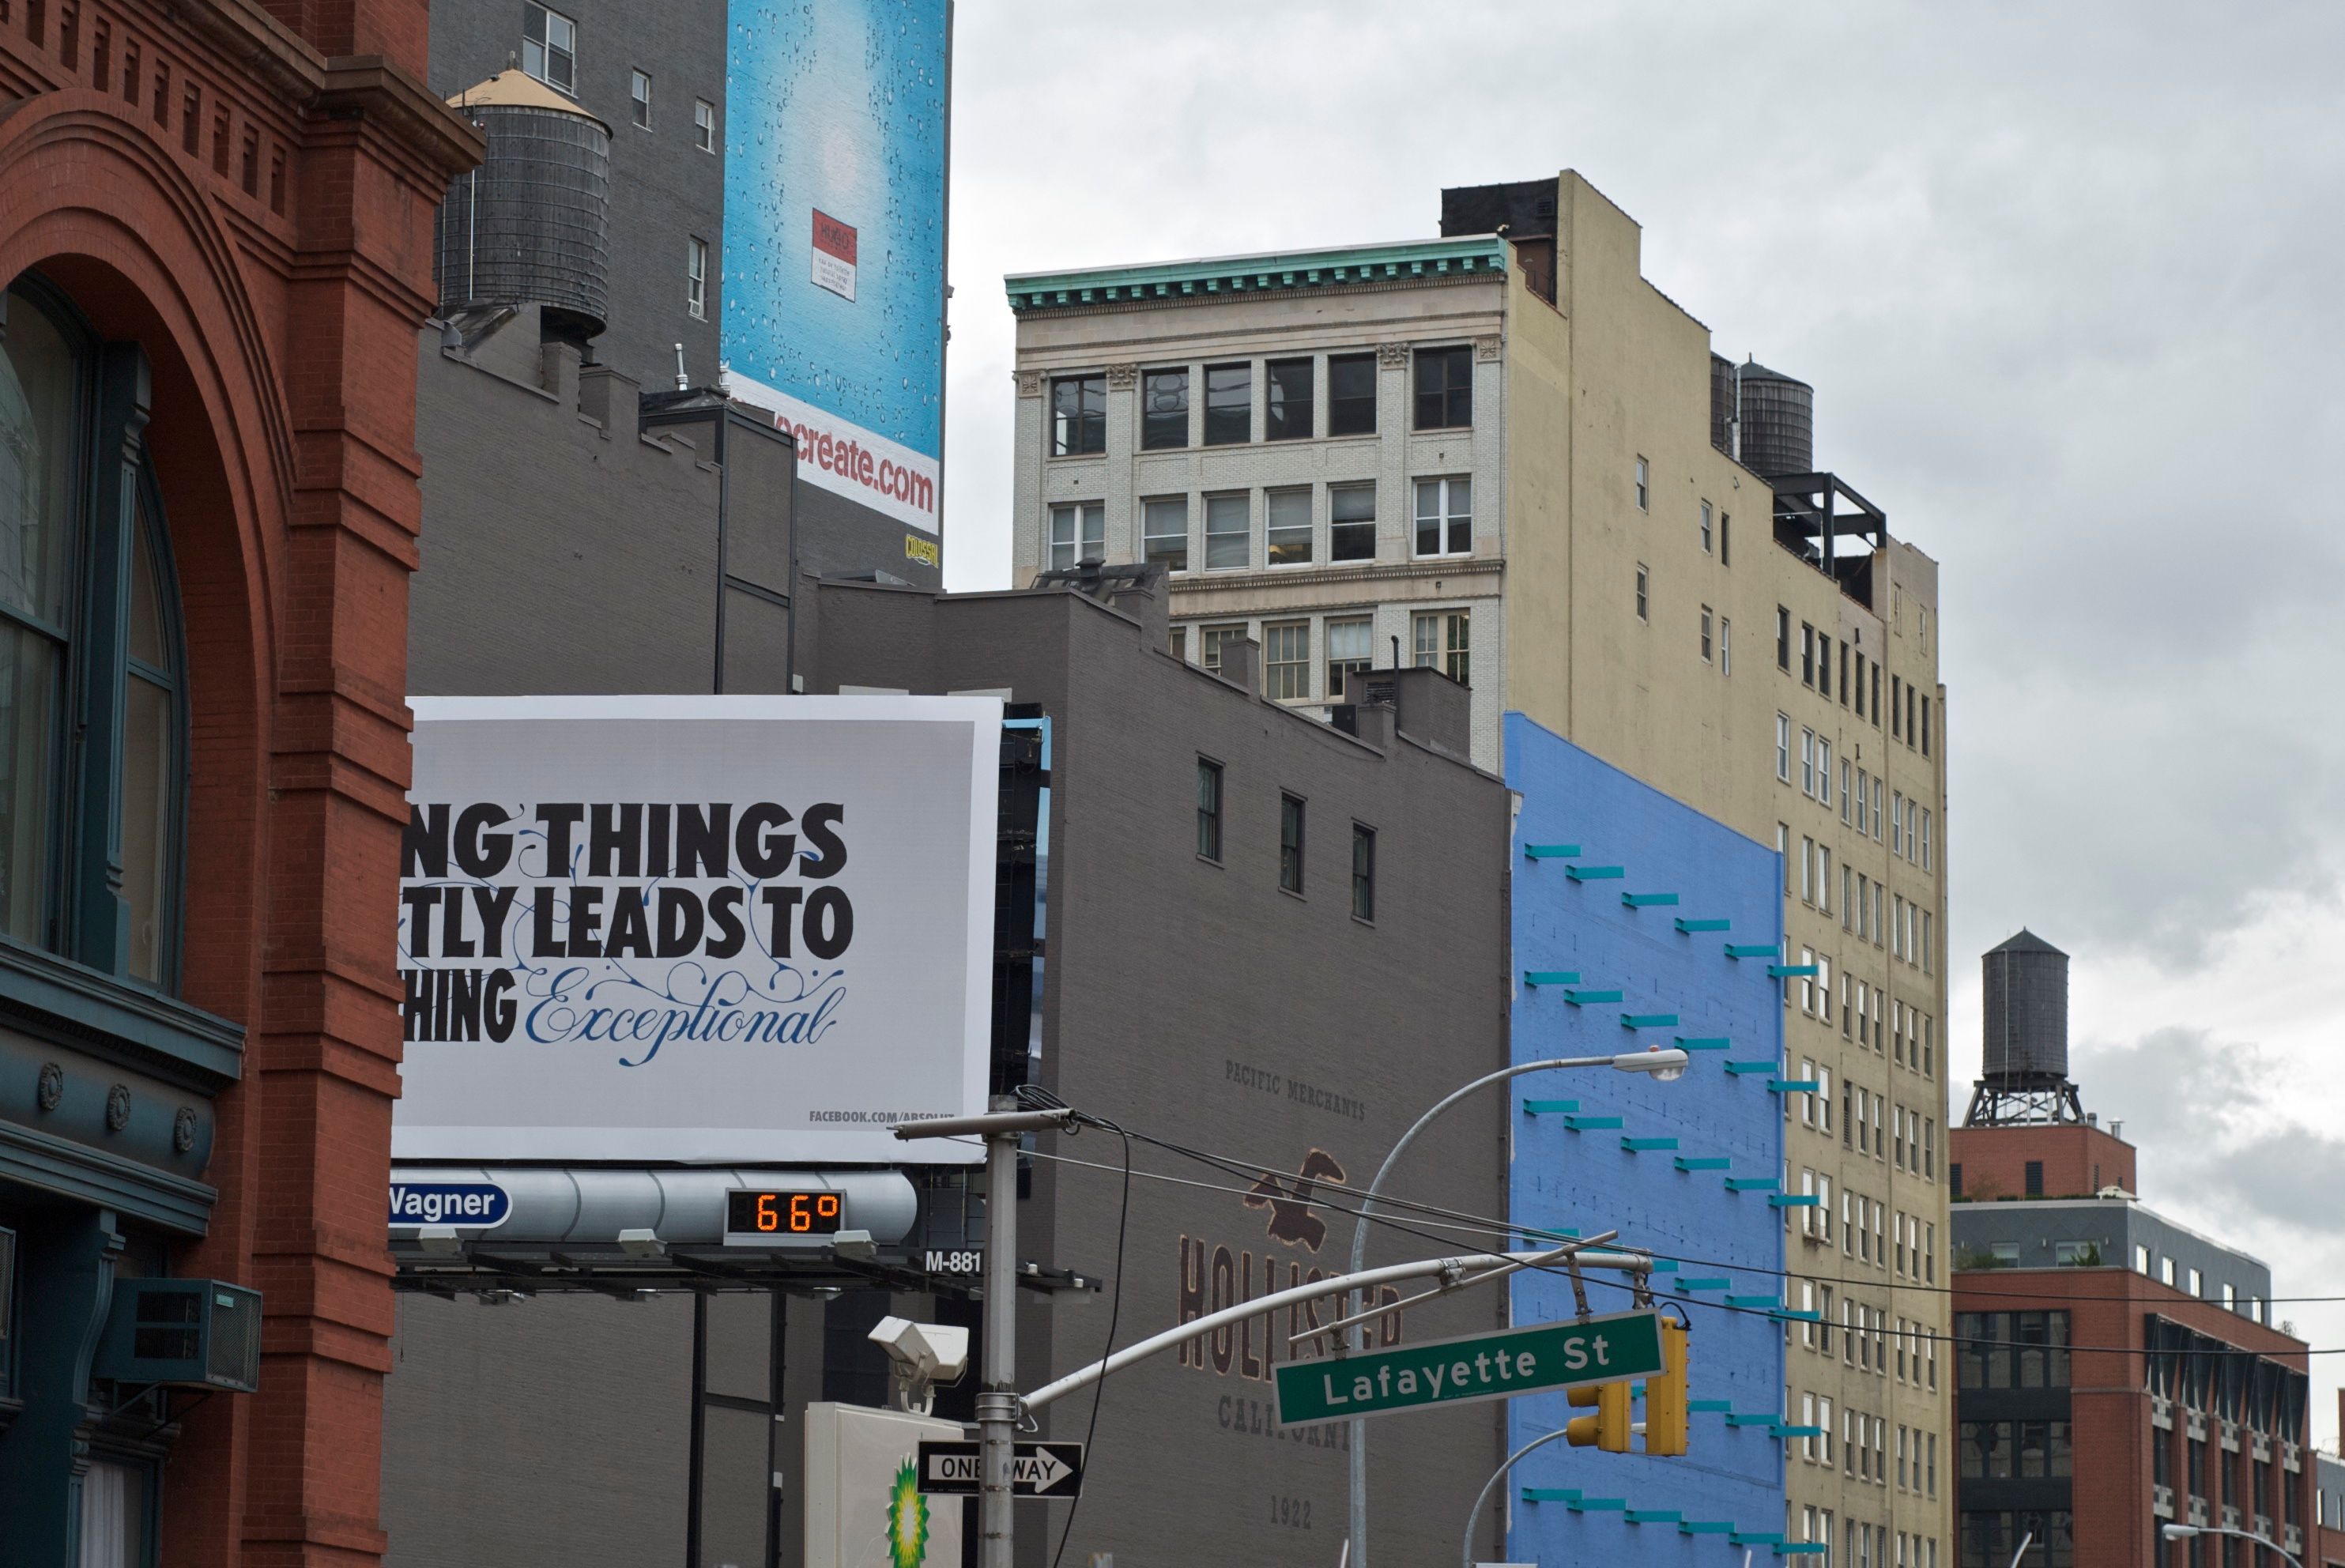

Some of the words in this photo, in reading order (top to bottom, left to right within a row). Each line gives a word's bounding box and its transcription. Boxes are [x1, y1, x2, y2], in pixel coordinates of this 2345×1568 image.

[534, 802, 848, 880] THINGS
[402, 886, 519, 959] TLY
[531, 886, 746, 959] LEADS
[762, 885, 854, 960] TO
[398, 967, 518, 1043] HING
[525, 964, 846, 1067] Exceptional
[1226, 1059, 1280, 1095] PACIFIC
[1287, 1079, 1366, 1121] MERCHANTS
[926, 1250, 982, 1272] M-881
[1323, 1348, 1537, 1406] Lafayette
[1563, 1334, 1611, 1370] St
[1270, 1494, 1312, 1530] 1922
